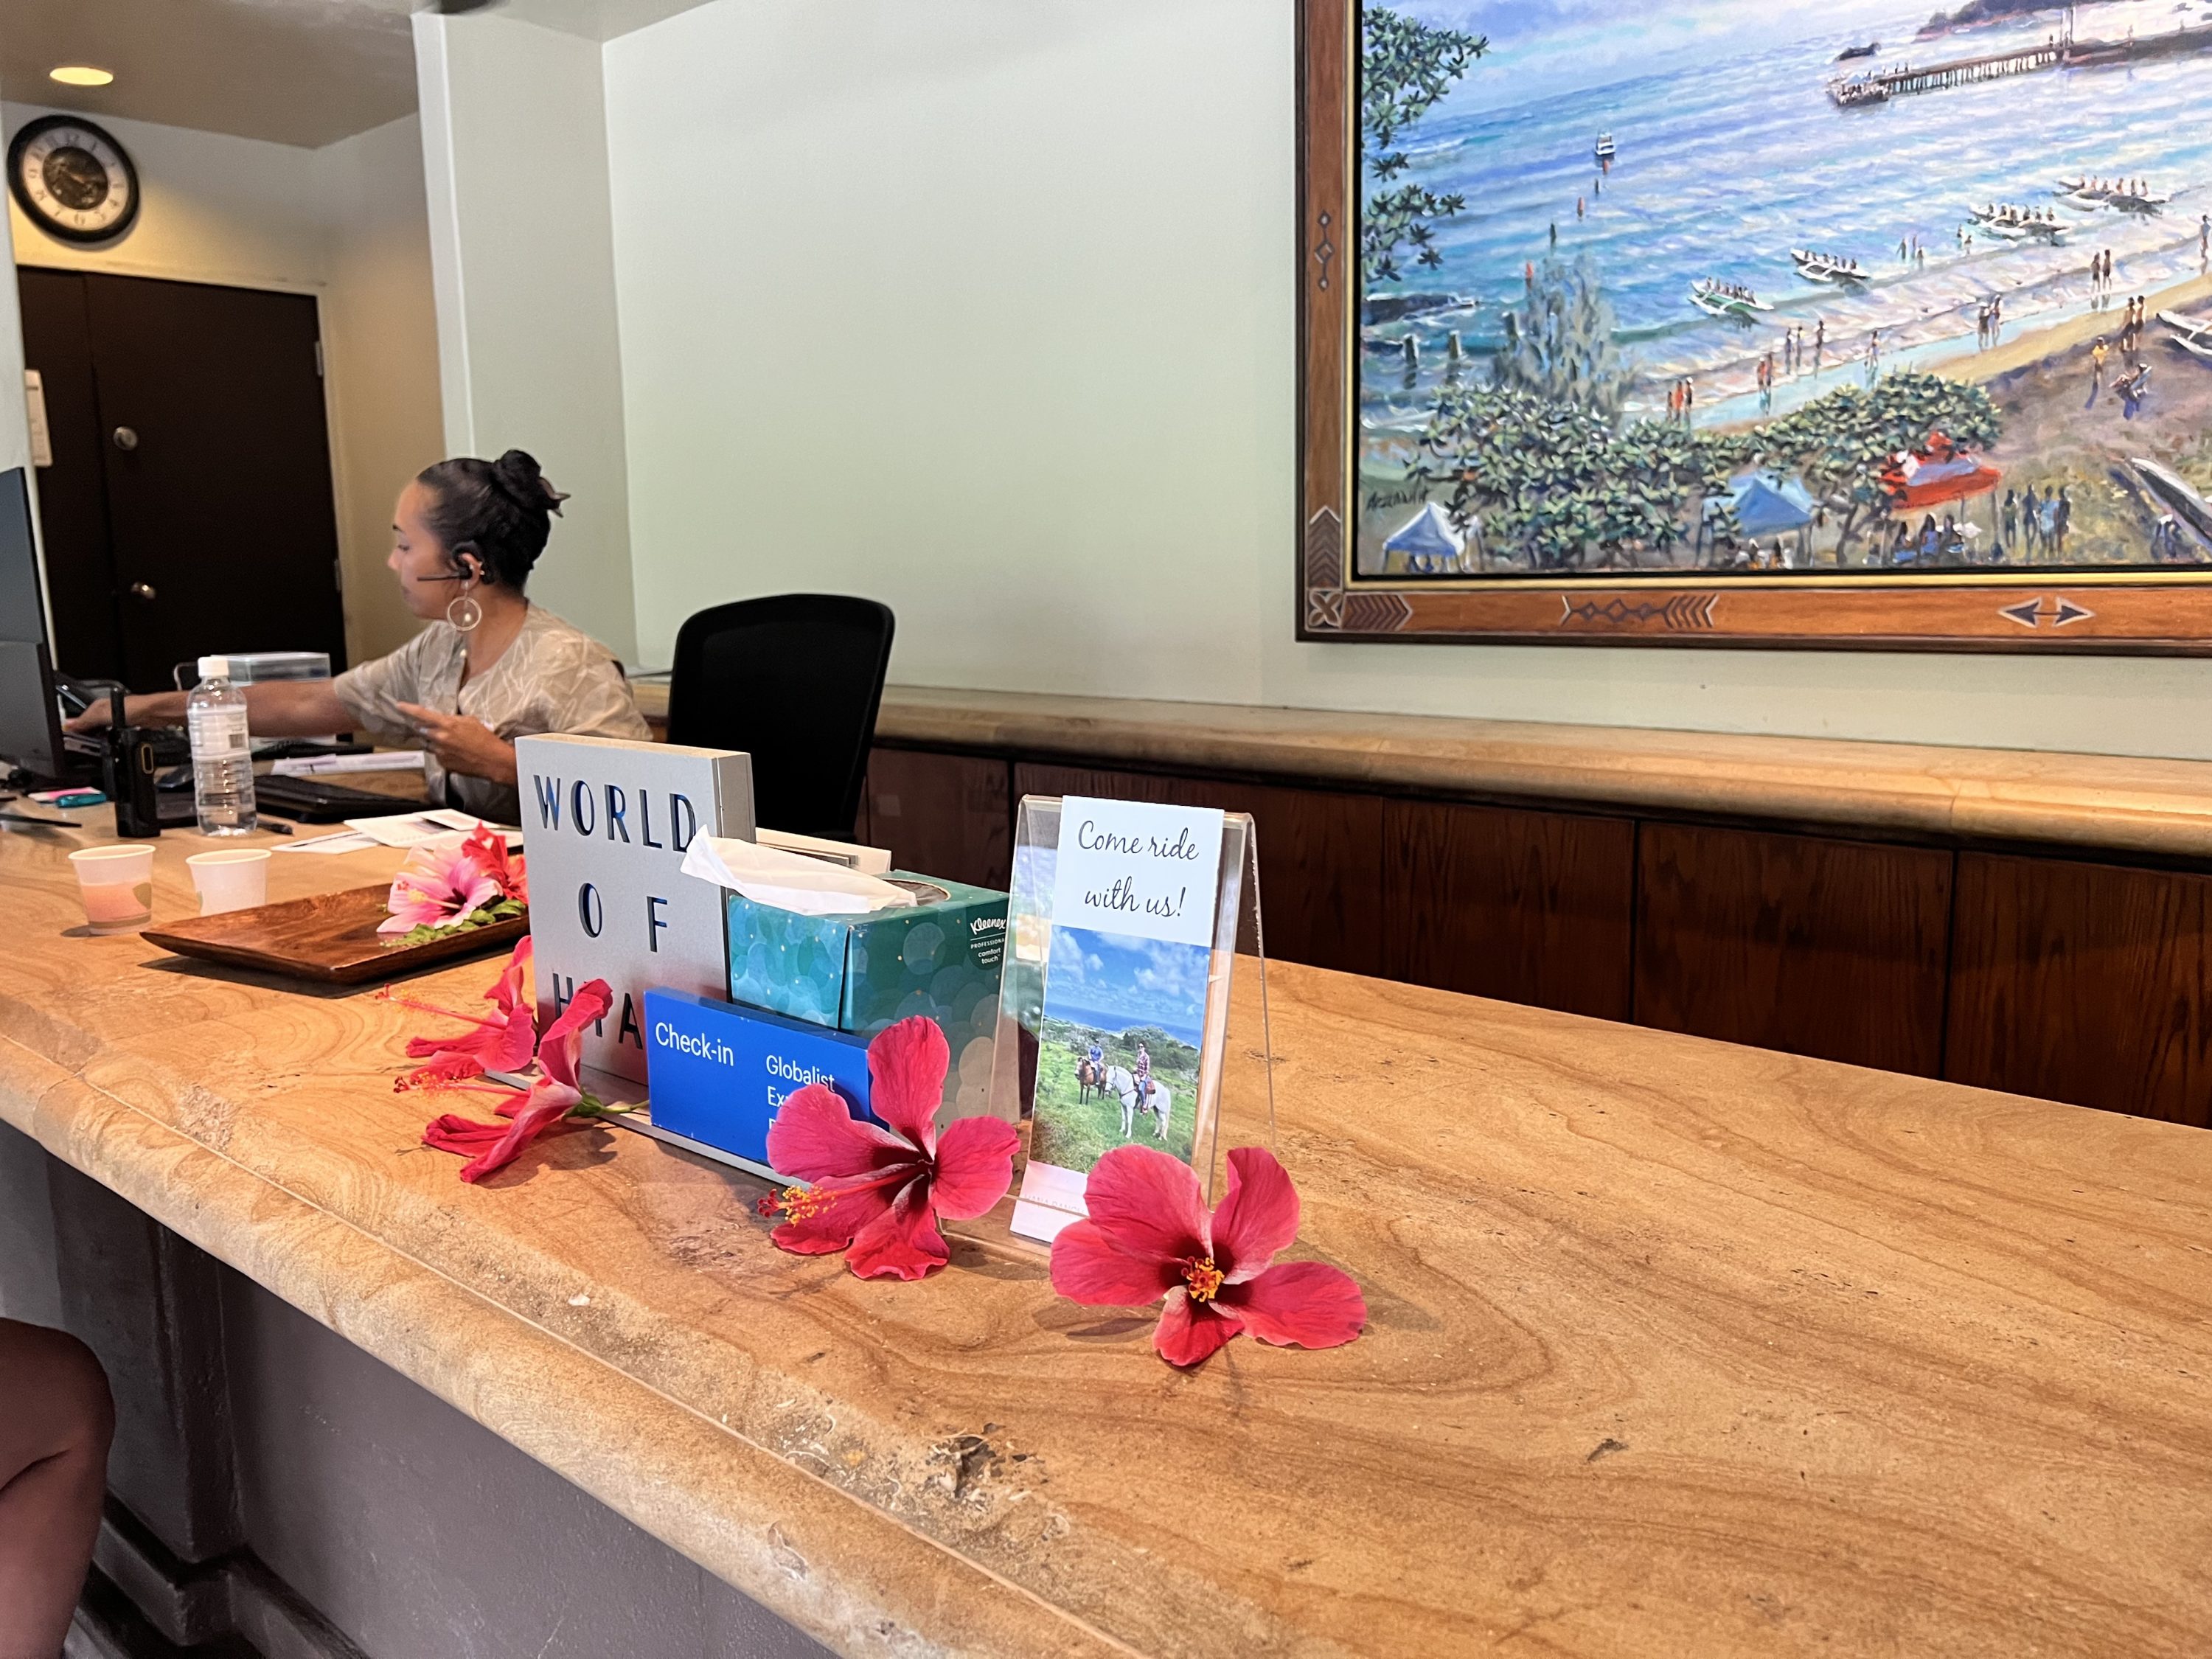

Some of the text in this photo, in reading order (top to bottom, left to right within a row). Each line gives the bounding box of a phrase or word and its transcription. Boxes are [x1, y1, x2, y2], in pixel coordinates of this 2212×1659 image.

[534, 774, 697, 853] WORLD
[1078, 820, 1200, 860] Come ride
[1085, 875, 1186, 917] with us!
[970, 917, 1006, 936] Kleenex
[970, 937, 1005, 949] PROFESSIONA
[978, 947, 1001, 958] comfort
[981, 955, 998, 964] touch
[655, 1022, 734, 1067] Check-in
[766, 1054, 835, 1093] Globalist
